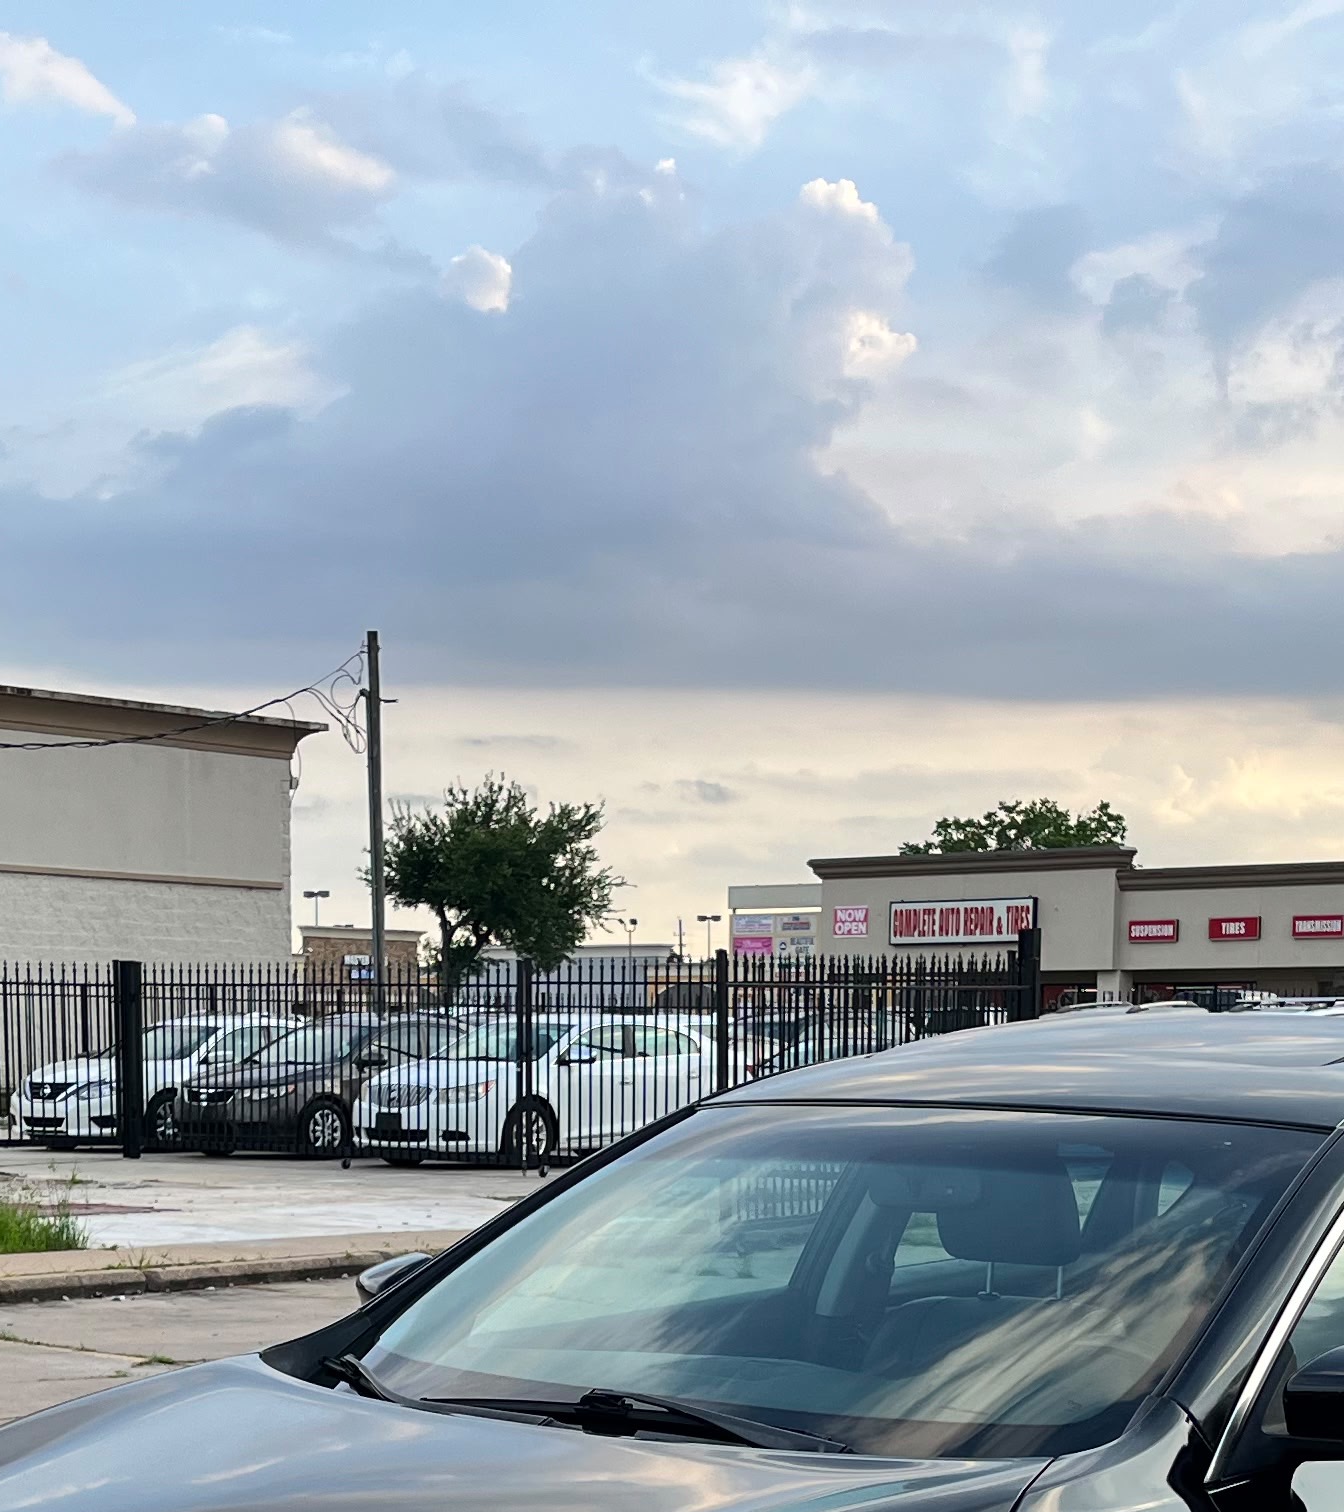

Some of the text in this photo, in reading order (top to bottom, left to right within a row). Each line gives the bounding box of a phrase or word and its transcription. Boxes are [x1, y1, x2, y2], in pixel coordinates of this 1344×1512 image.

[836, 909, 866, 922] NOW
[893, 907, 936, 938] COMPLETE
[938, 907, 960, 937] AUTO
[963, 905, 994, 937] REPAIR
[1006, 905, 1031, 935] TIRES
[835, 922, 867, 934] OPEN
[1130, 924, 1174, 937] SUSPENSION
[1221, 921, 1246, 935] TIRES
